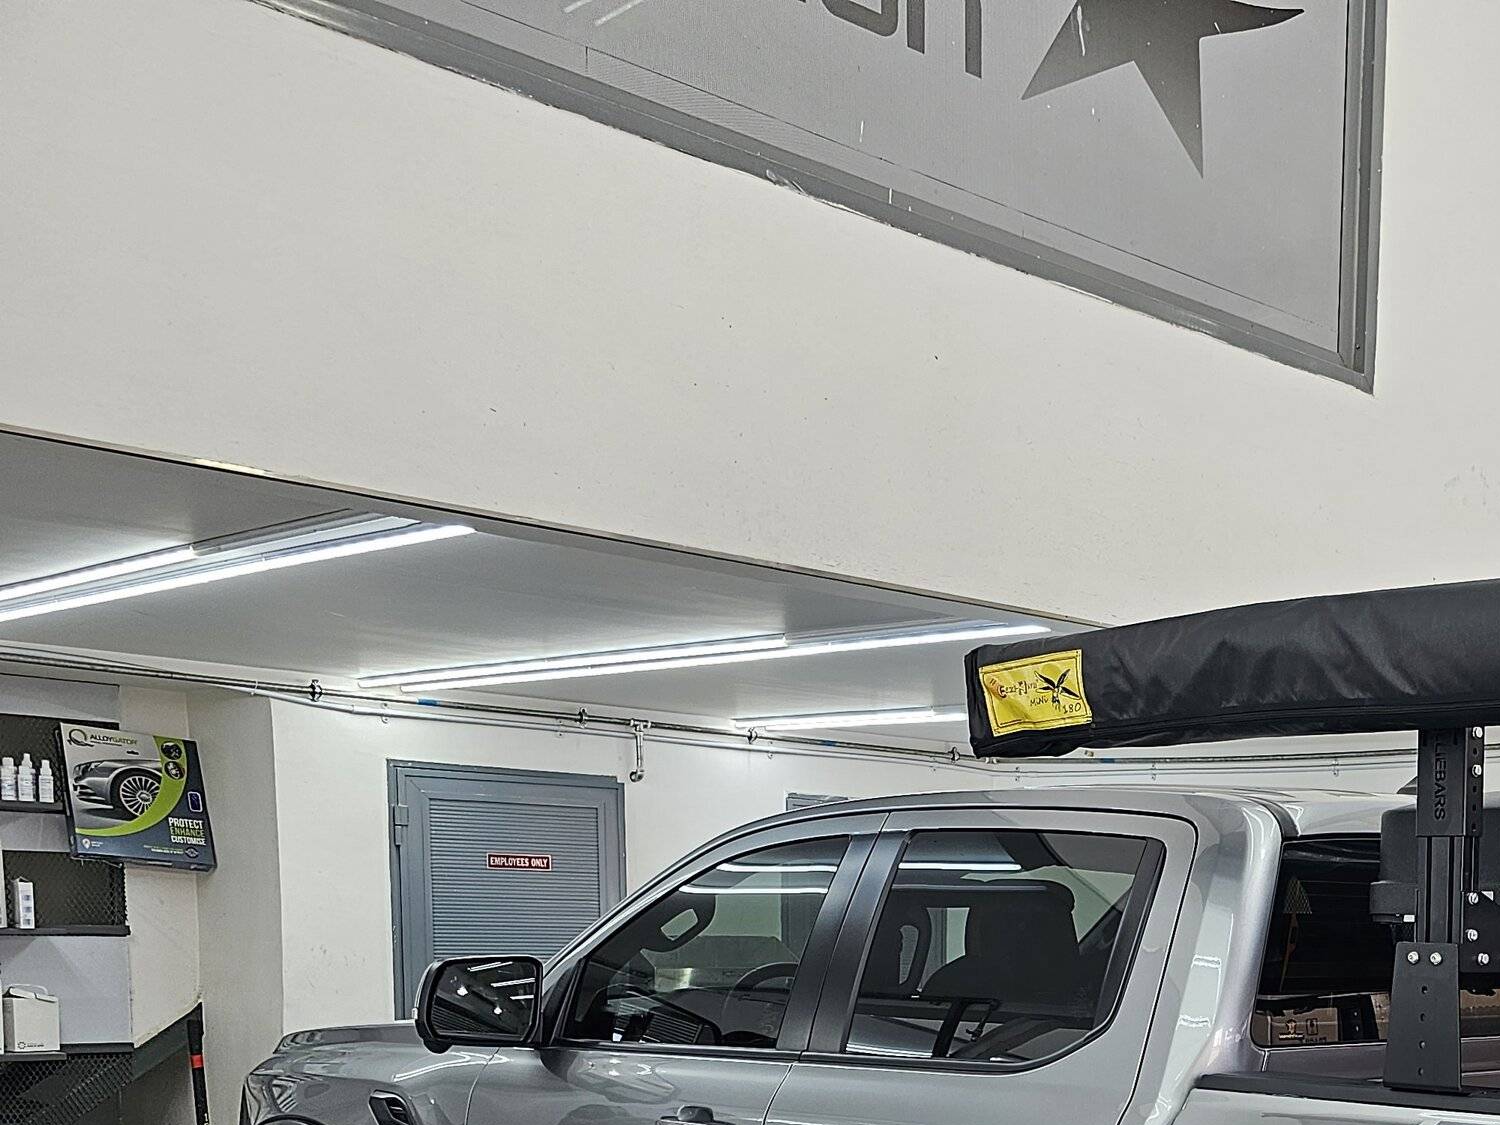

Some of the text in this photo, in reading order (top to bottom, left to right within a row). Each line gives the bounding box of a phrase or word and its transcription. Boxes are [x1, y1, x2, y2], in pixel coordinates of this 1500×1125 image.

[168, 817, 204, 830] PROTECT
[170, 827, 206, 838] ENHANCE
[171, 835, 207, 847] CUSTOMISE
[490, 856, 548, 868] EMPLOYEES ONLY
